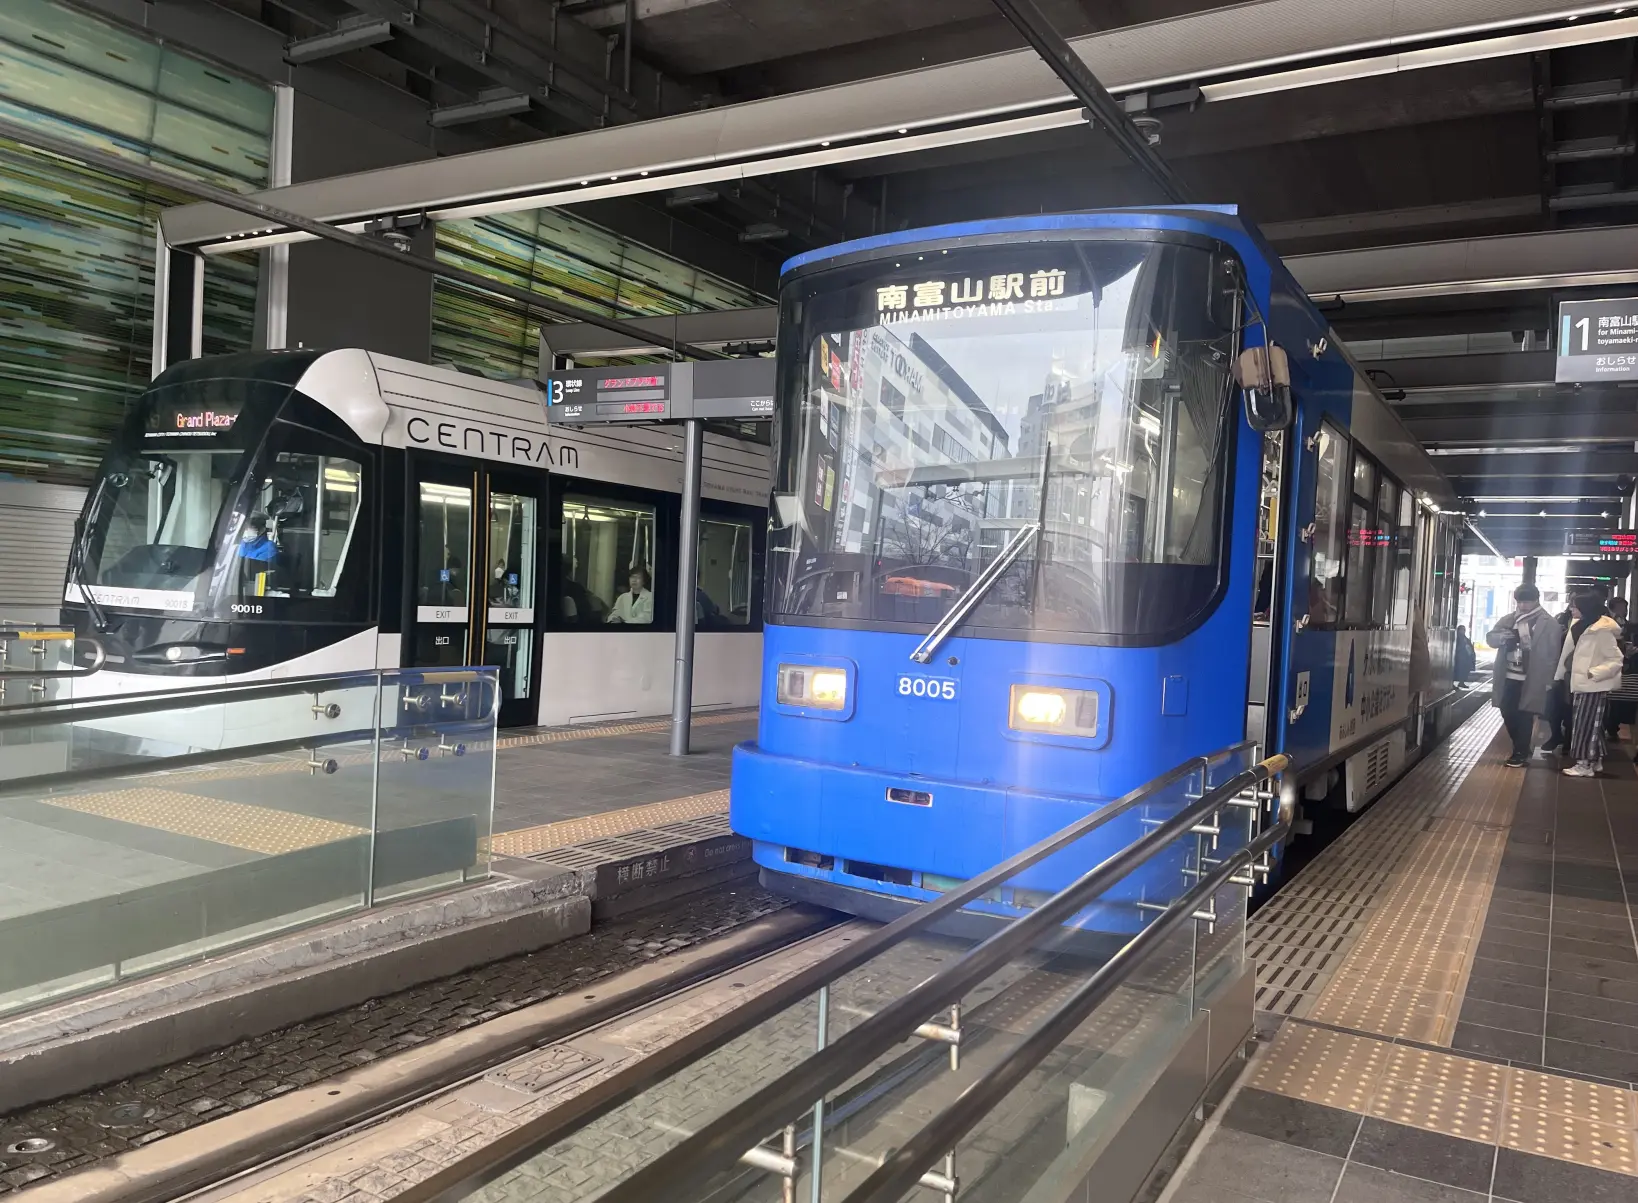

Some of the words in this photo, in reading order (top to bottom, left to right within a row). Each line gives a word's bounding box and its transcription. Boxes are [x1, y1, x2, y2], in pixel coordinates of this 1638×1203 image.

[876, 268, 1067, 311] 南富山駅前
[879, 301, 1017, 325] MINAMITOYAMA
[1024, 300, 1060, 314] Sta.
[1575, 317, 1590, 351] 1
[1598, 328, 1609, 336] for
[1597, 336, 1638, 346] toyamaeki-
[1596, 355, 1637, 366] おしらせ
[552, 380, 564, 404] 3
[564, 405, 583, 413] おしらせ
[177, 412, 204, 429] Grand
[407, 417, 579, 469] CENTRAM
[164, 599, 188, 609] 9001B
[231, 604, 263, 614] 9001B
[435, 610, 451, 619] EXIT
[504, 611, 518, 620] EXIT
[435, 636, 449, 645] 出口
[504, 636, 517, 645] 出口
[899, 677, 955, 699] 8005
[617, 855, 671, 885] 横断禁止
